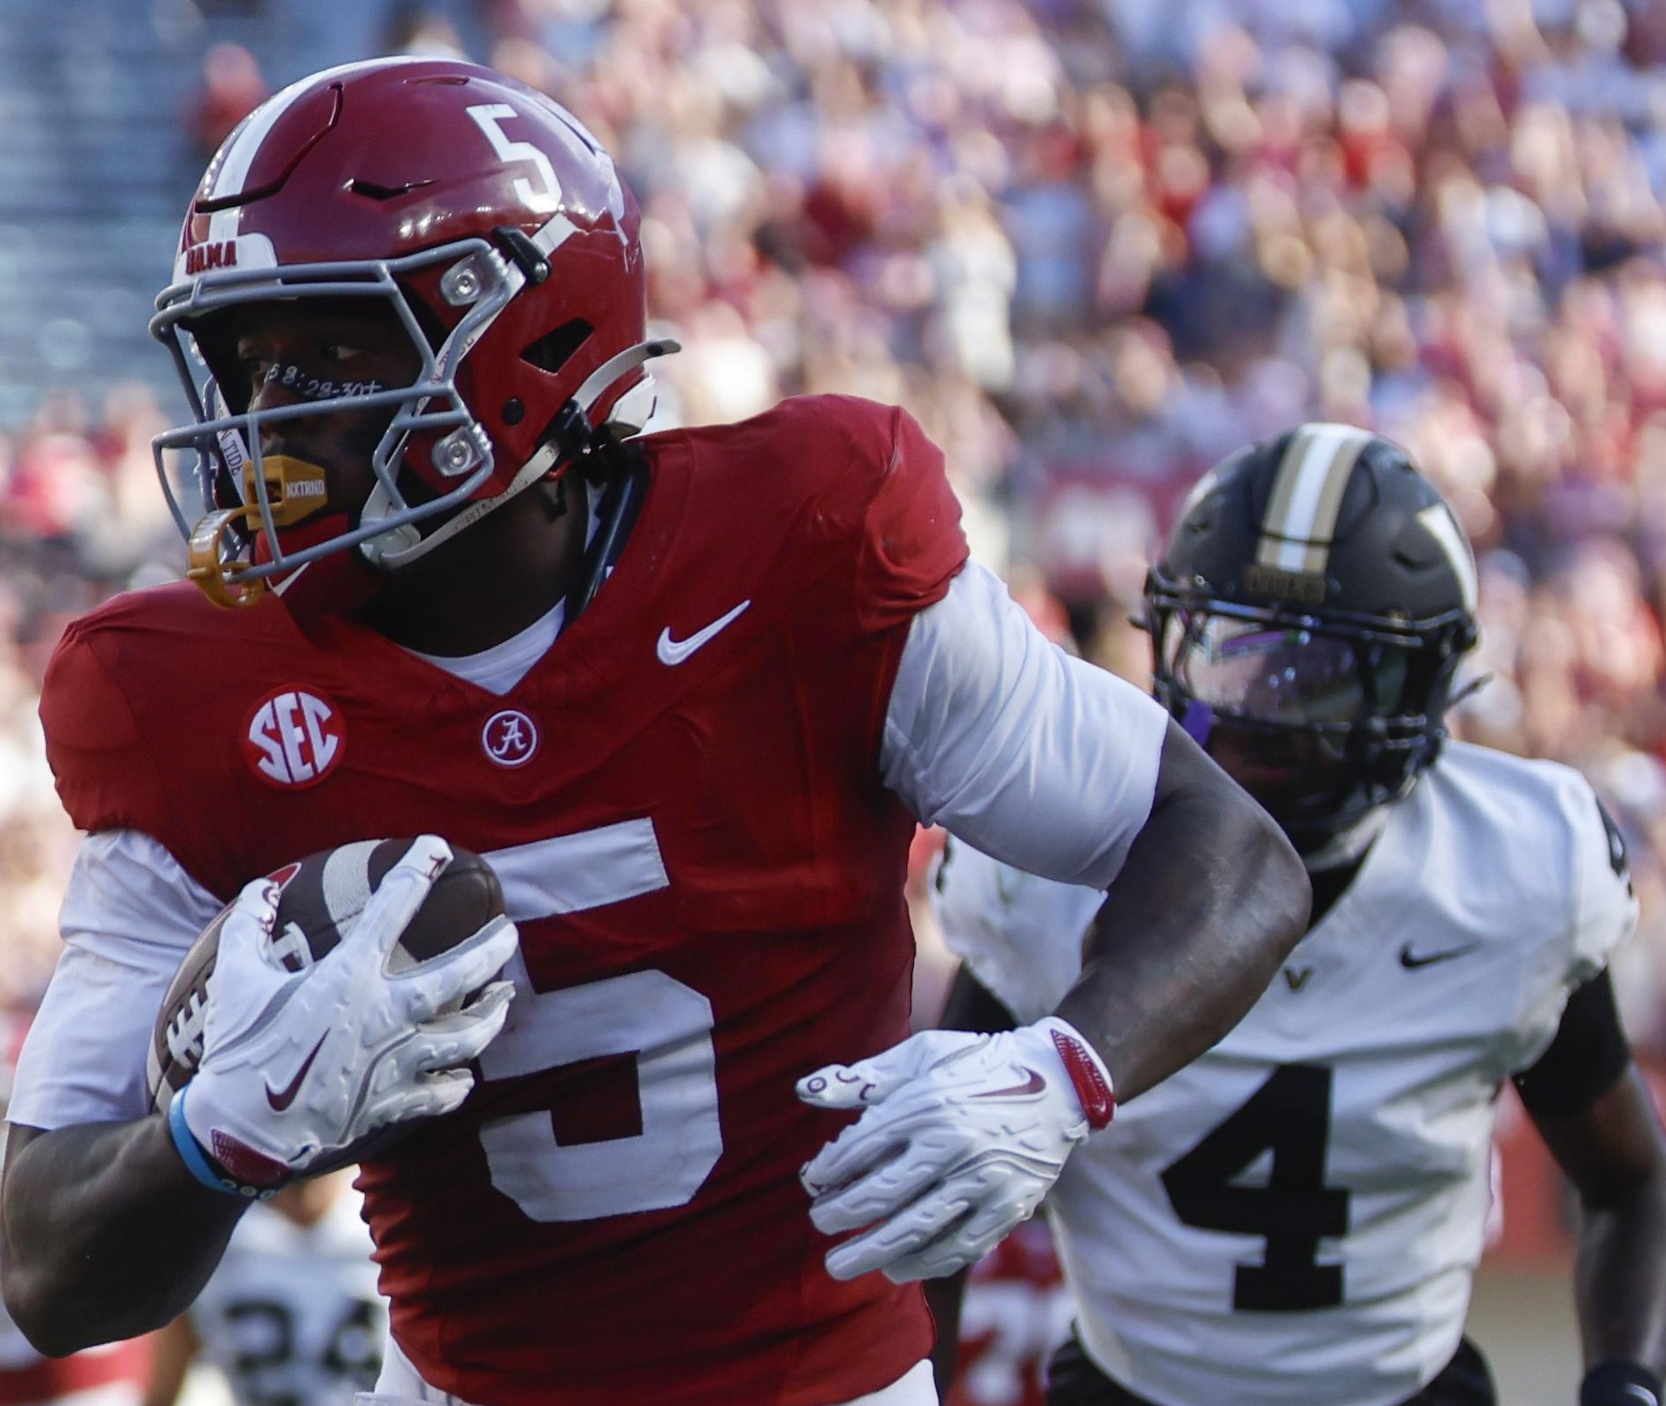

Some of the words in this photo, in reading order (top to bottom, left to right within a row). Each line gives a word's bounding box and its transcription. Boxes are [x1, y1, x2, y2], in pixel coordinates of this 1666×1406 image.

[465, 104, 562, 212] 5
[249, 692, 339, 784] SEC
[493, 718, 527, 755] A
[479, 816, 723, 1222] 5
[1161, 1064, 1351, 1313] 4
